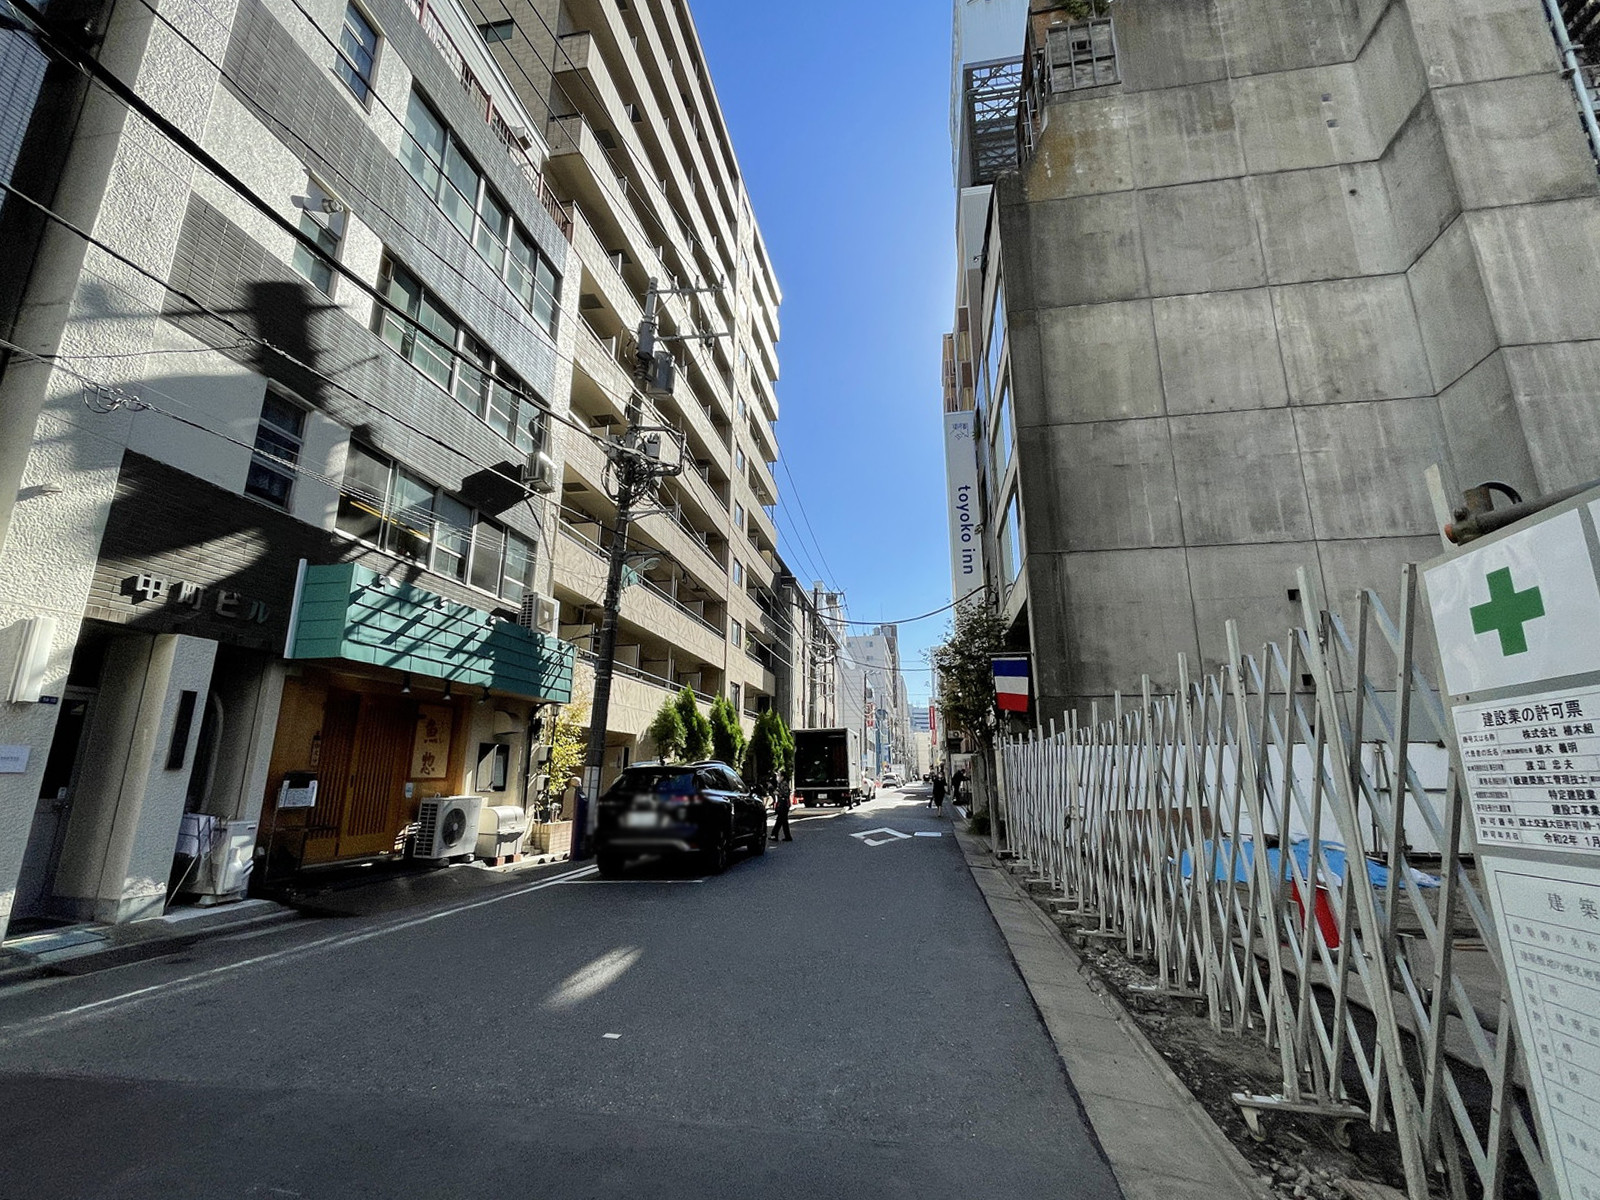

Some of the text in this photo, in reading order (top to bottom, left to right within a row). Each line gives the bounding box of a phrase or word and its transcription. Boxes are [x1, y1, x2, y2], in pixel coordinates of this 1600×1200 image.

[956, 485, 976, 574] toyoko inn
[1481, 699, 1583, 727] 建設業の許可票
[1522, 726, 1558, 740] 株式会社
[1543, 832, 1578, 846] 令和2年
